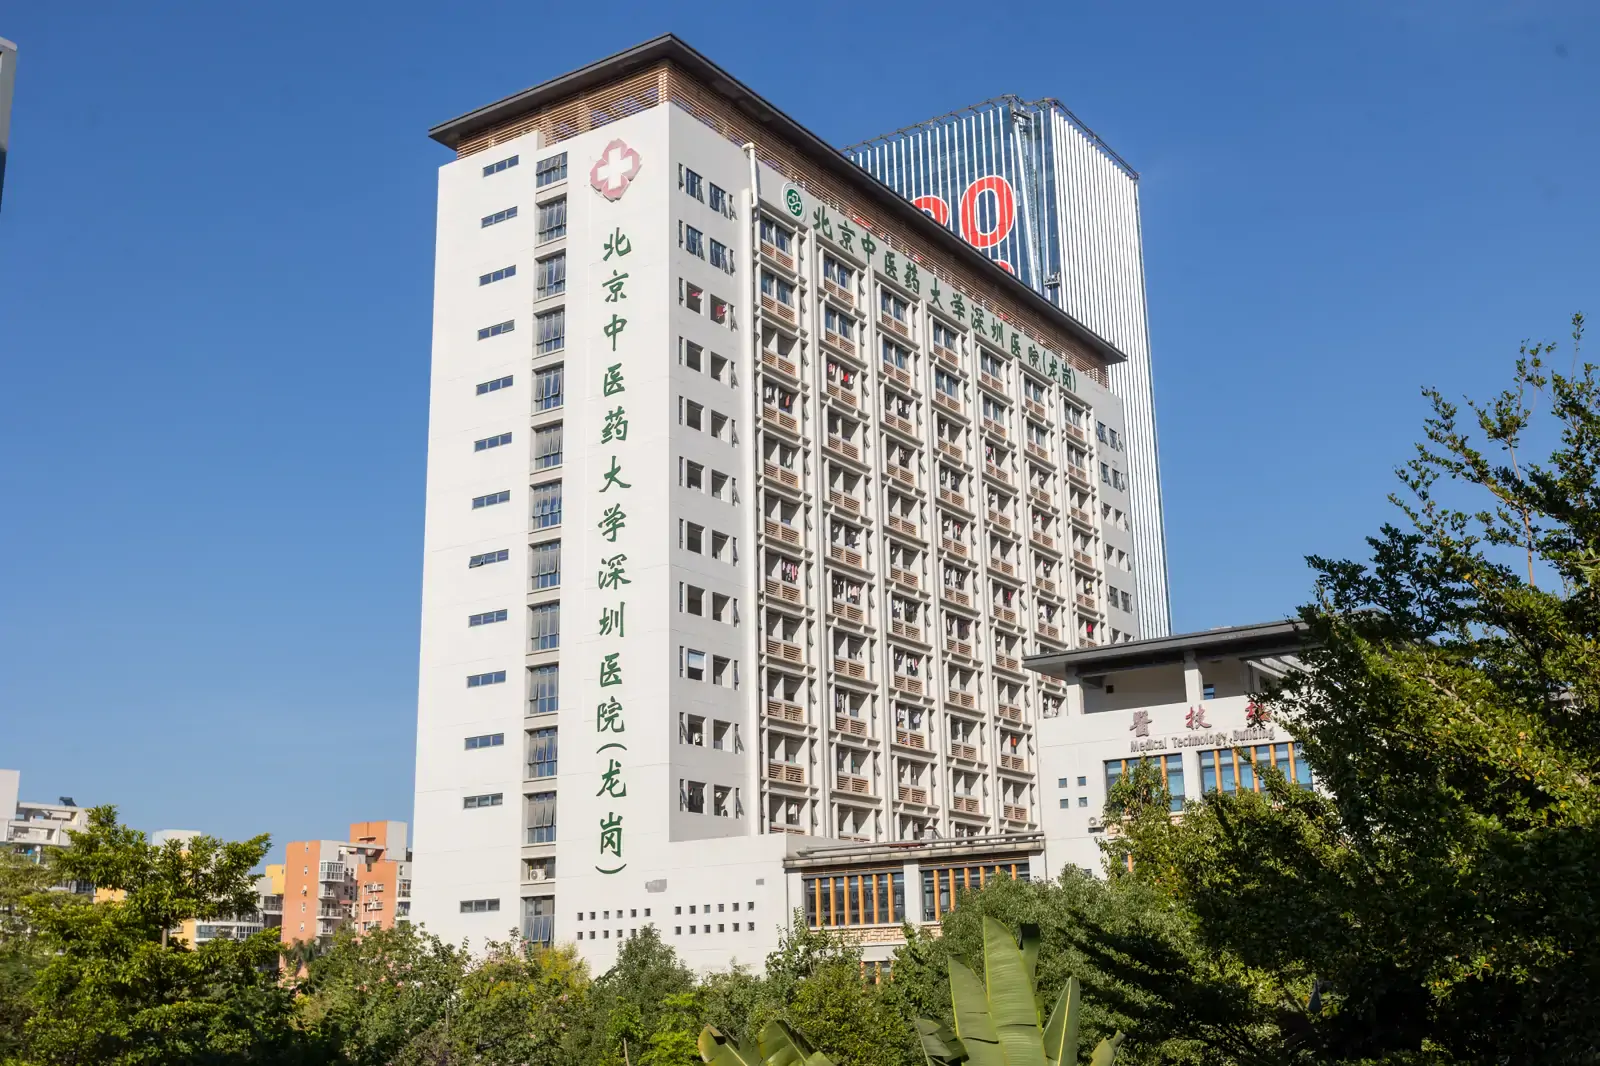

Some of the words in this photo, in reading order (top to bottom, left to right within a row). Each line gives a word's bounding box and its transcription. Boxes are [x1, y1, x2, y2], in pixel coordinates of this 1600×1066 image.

[1130, 737, 1168, 753] Medical
[1171, 731, 1228, 749] Technology
[1233, 726, 1276, 742] Building
